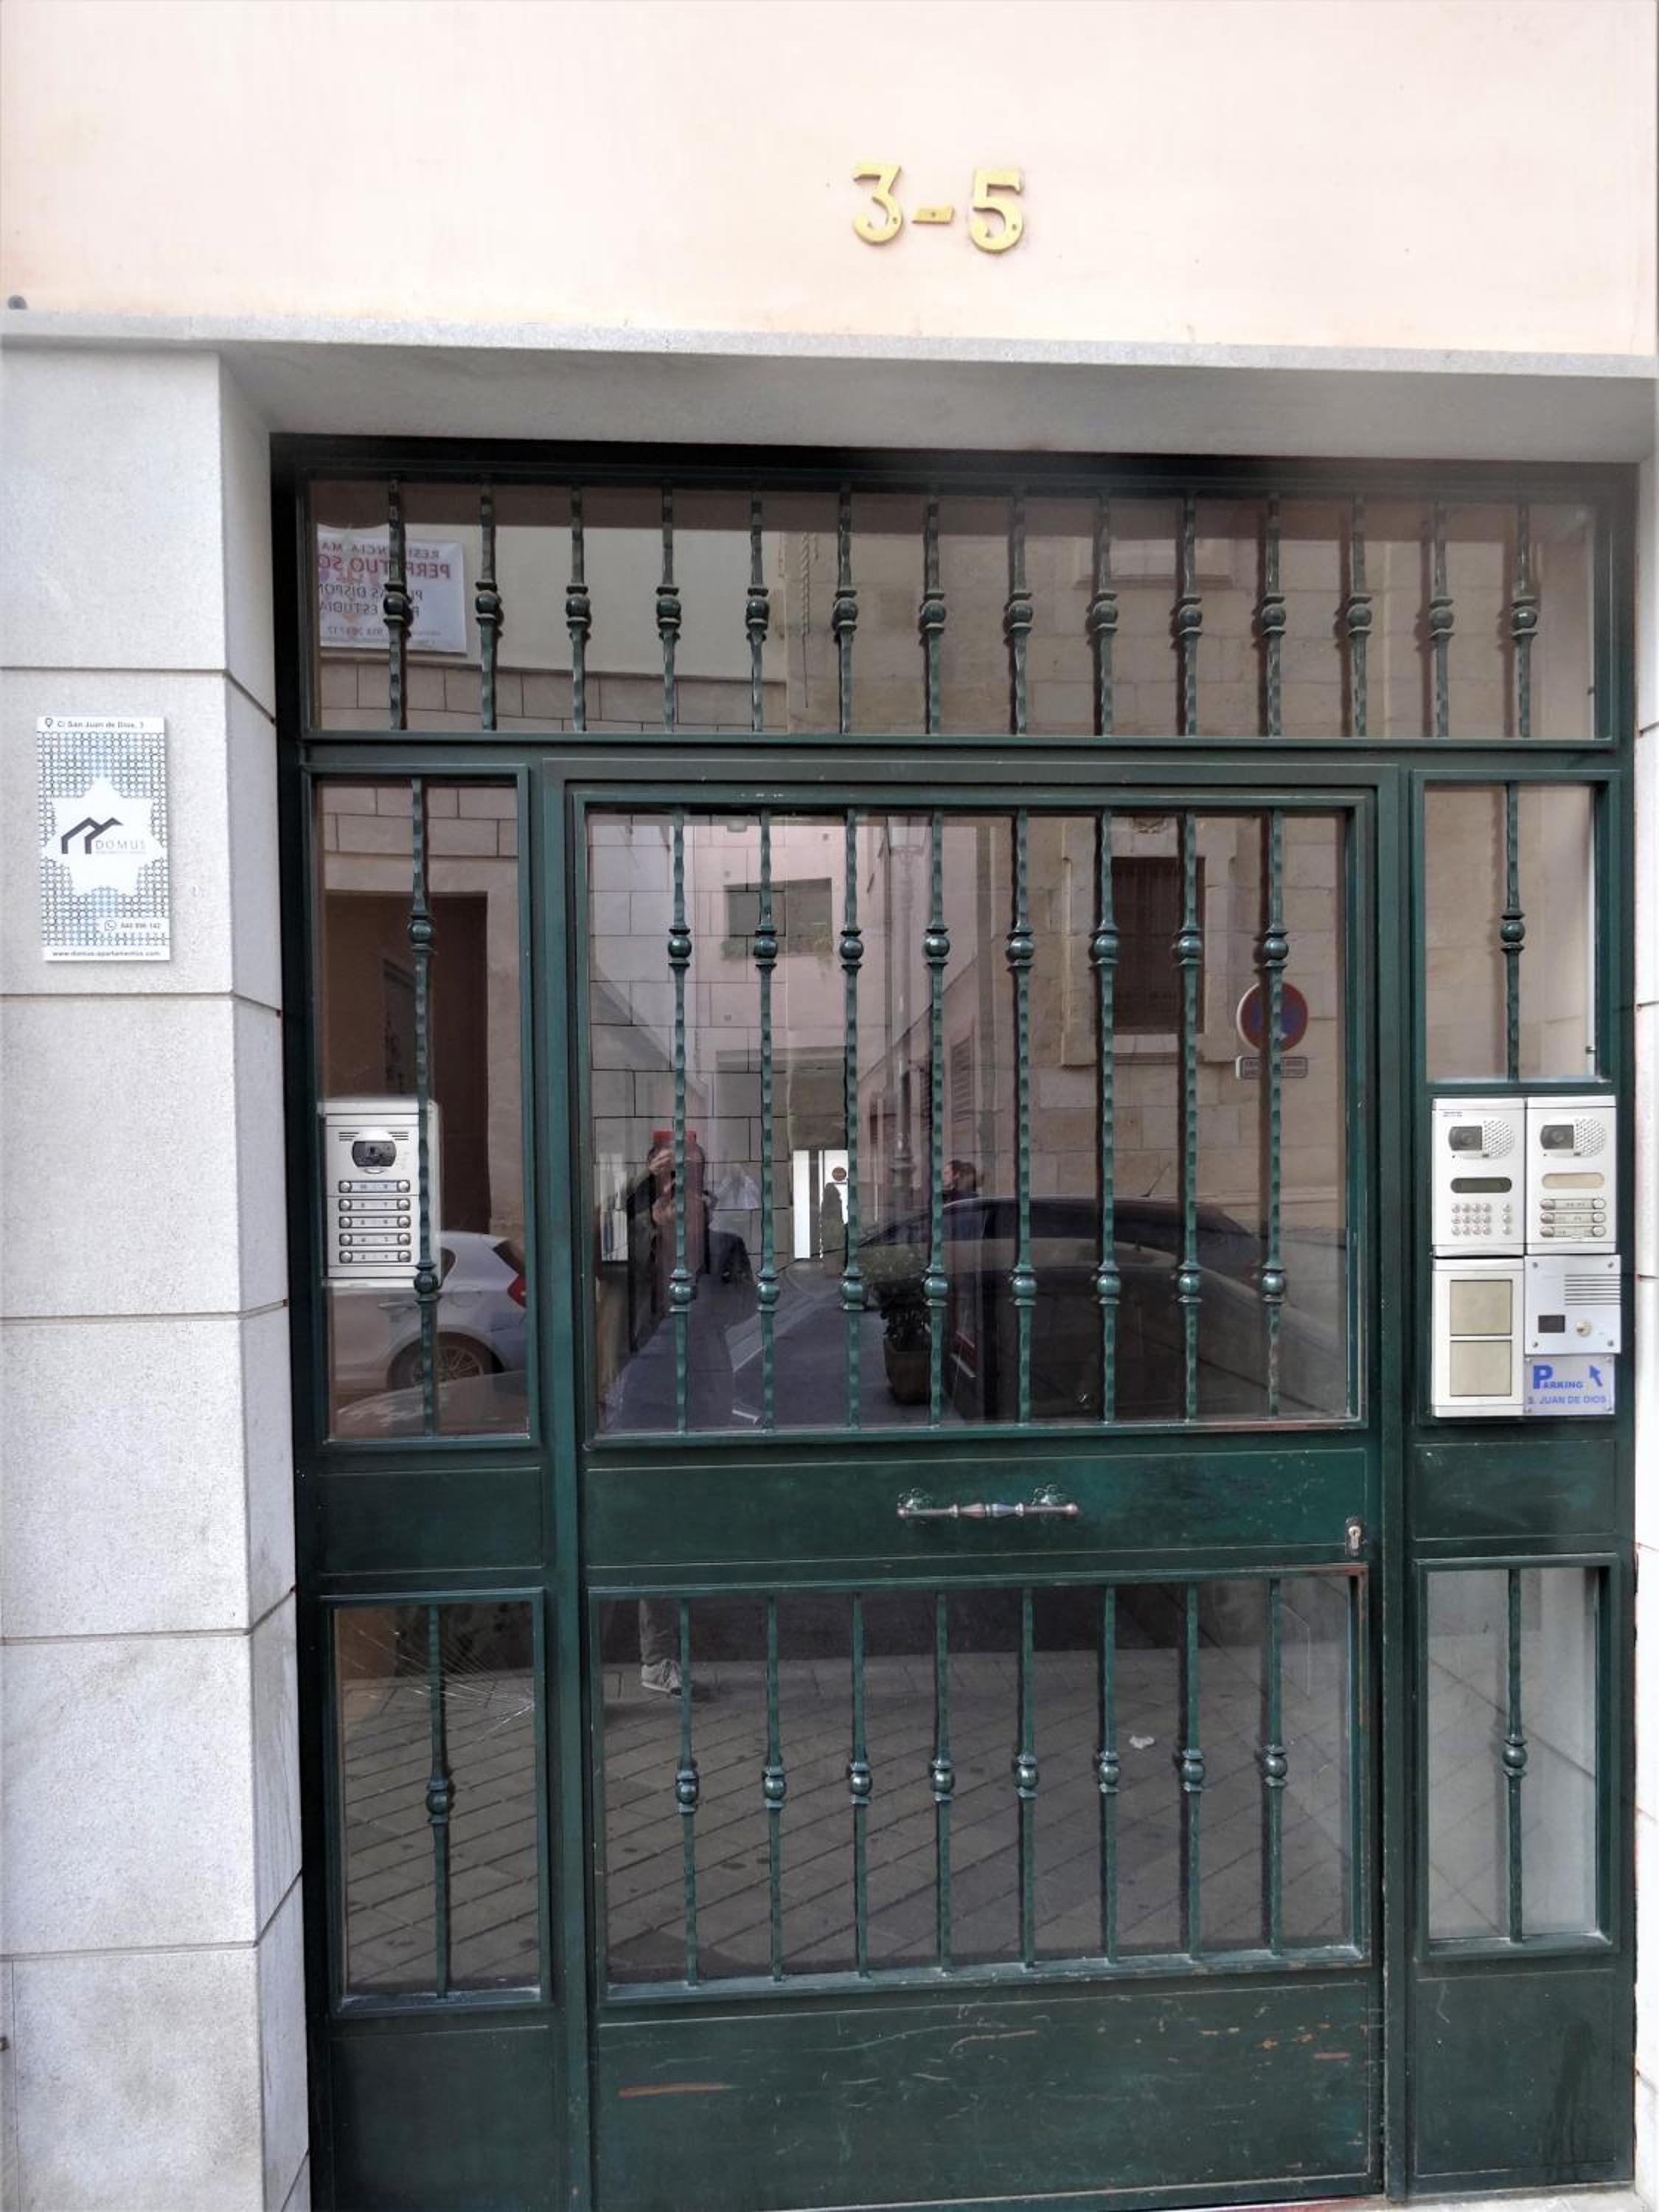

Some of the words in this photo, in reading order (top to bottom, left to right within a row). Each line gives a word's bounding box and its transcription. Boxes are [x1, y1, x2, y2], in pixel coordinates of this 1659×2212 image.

[95, 839, 146, 850] DOMUS
[1533, 1364, 1584, 1390] PARKING
[1540, 1396, 1566, 1404] JUAN
[1568, 1396, 1581, 1404] DE
[1583, 1395, 1606, 1404] DIOS
